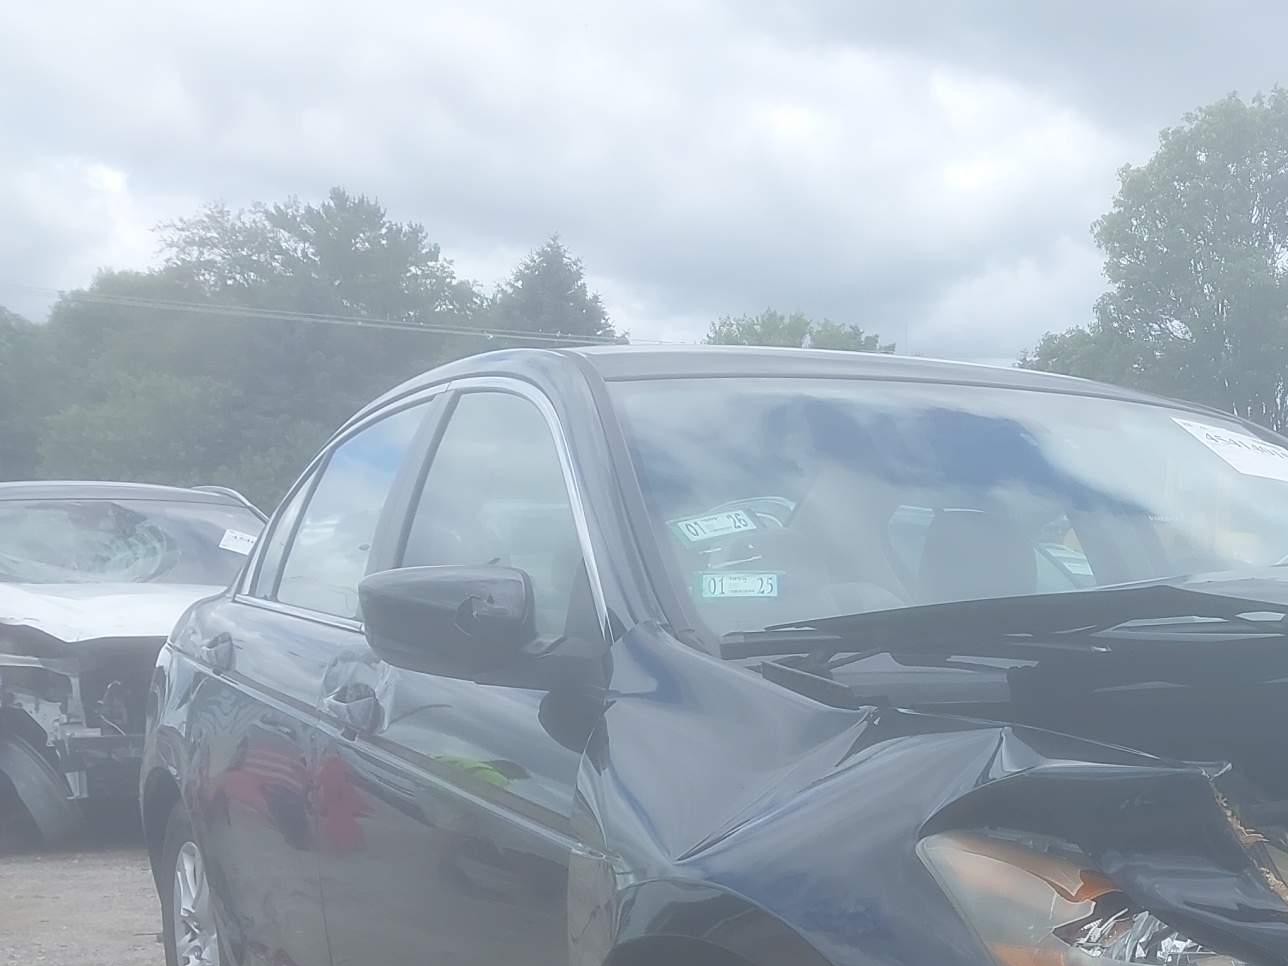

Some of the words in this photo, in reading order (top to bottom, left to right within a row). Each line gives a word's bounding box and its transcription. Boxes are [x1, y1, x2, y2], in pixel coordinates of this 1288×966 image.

[684, 521, 706, 537] 01
[726, 512, 748, 529] 26
[708, 577, 725, 595] 01
[757, 577, 773, 594] 25
